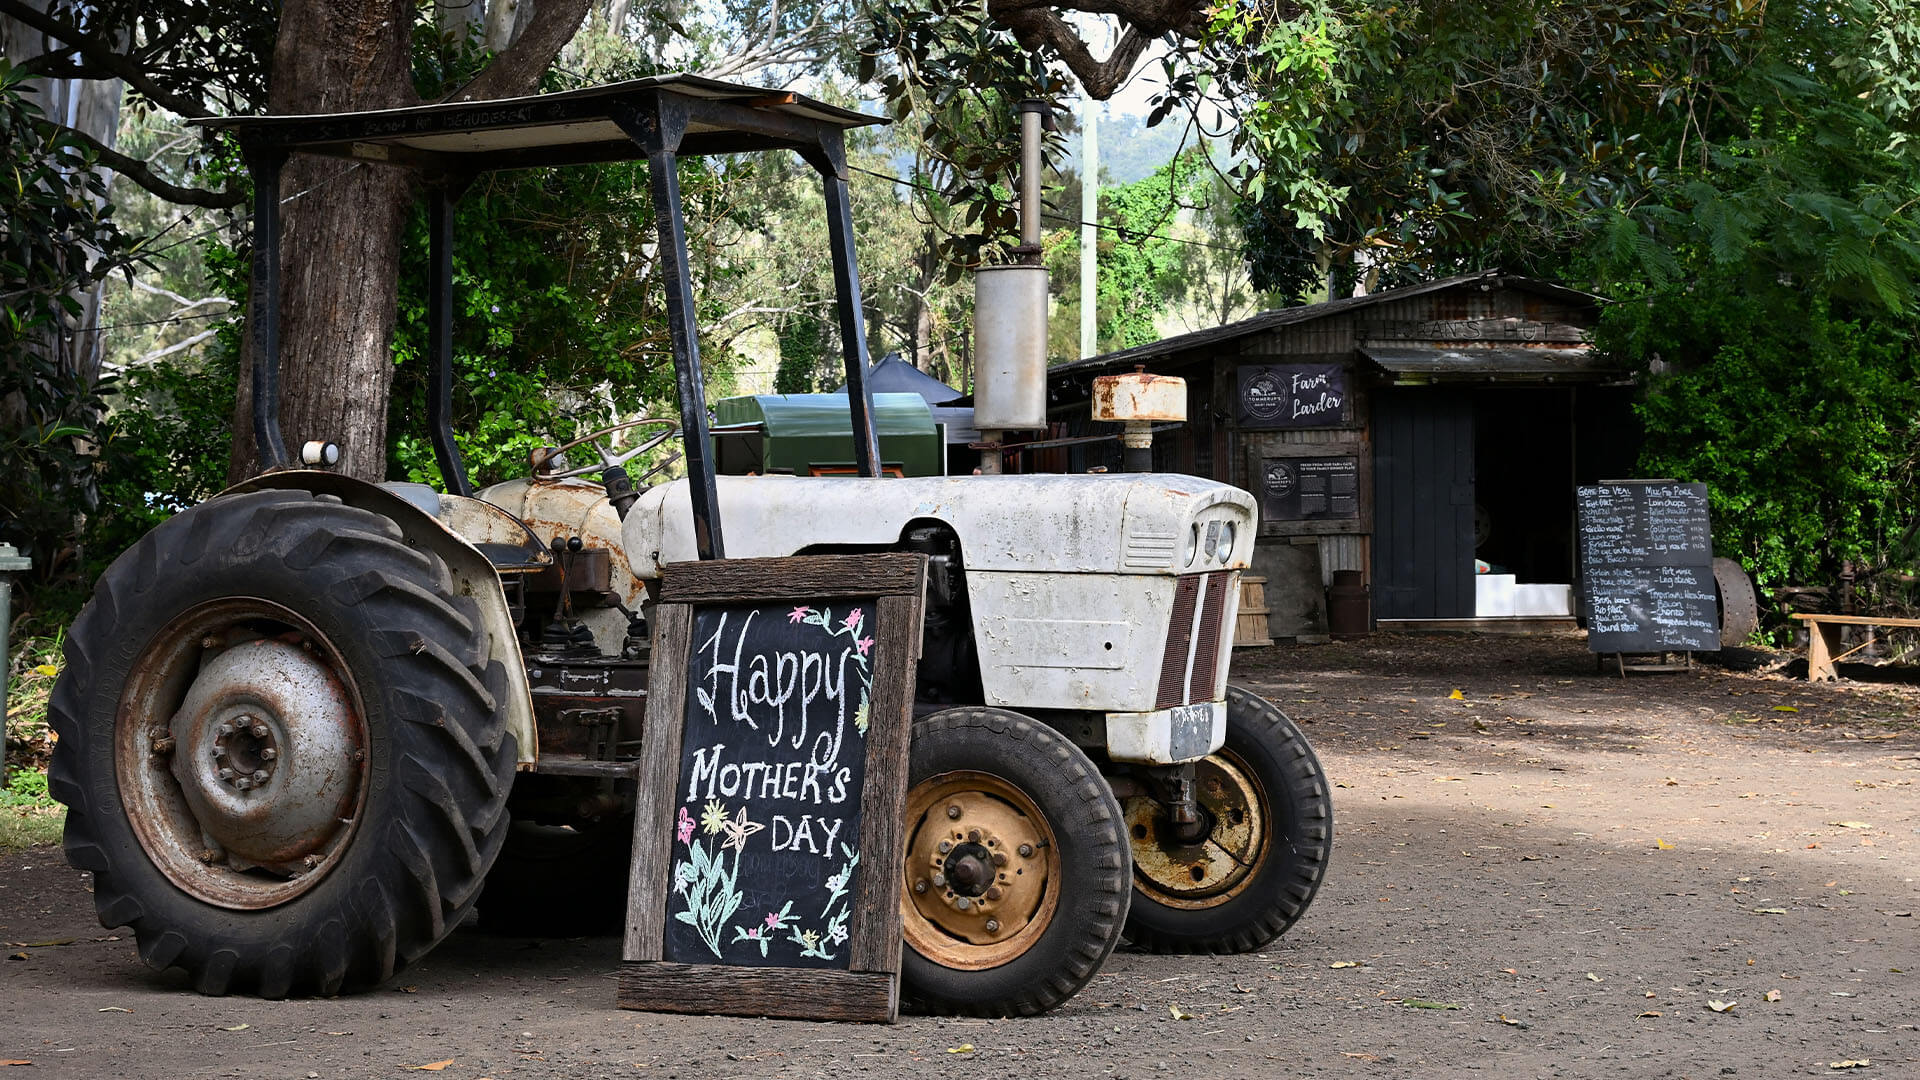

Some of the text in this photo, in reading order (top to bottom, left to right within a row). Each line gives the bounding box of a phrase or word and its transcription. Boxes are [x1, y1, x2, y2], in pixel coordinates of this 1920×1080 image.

[1503, 320, 1556, 340] HUT
[1292, 372, 1327, 394] Farm
[1292, 391, 1342, 420] Larder
[1659, 576, 1674, 588] Leg
[1597, 622, 1620, 633] Round
[697, 609, 851, 772] Happy
[686, 743, 851, 804] MOTHER'S
[771, 815, 843, 860] DAY
